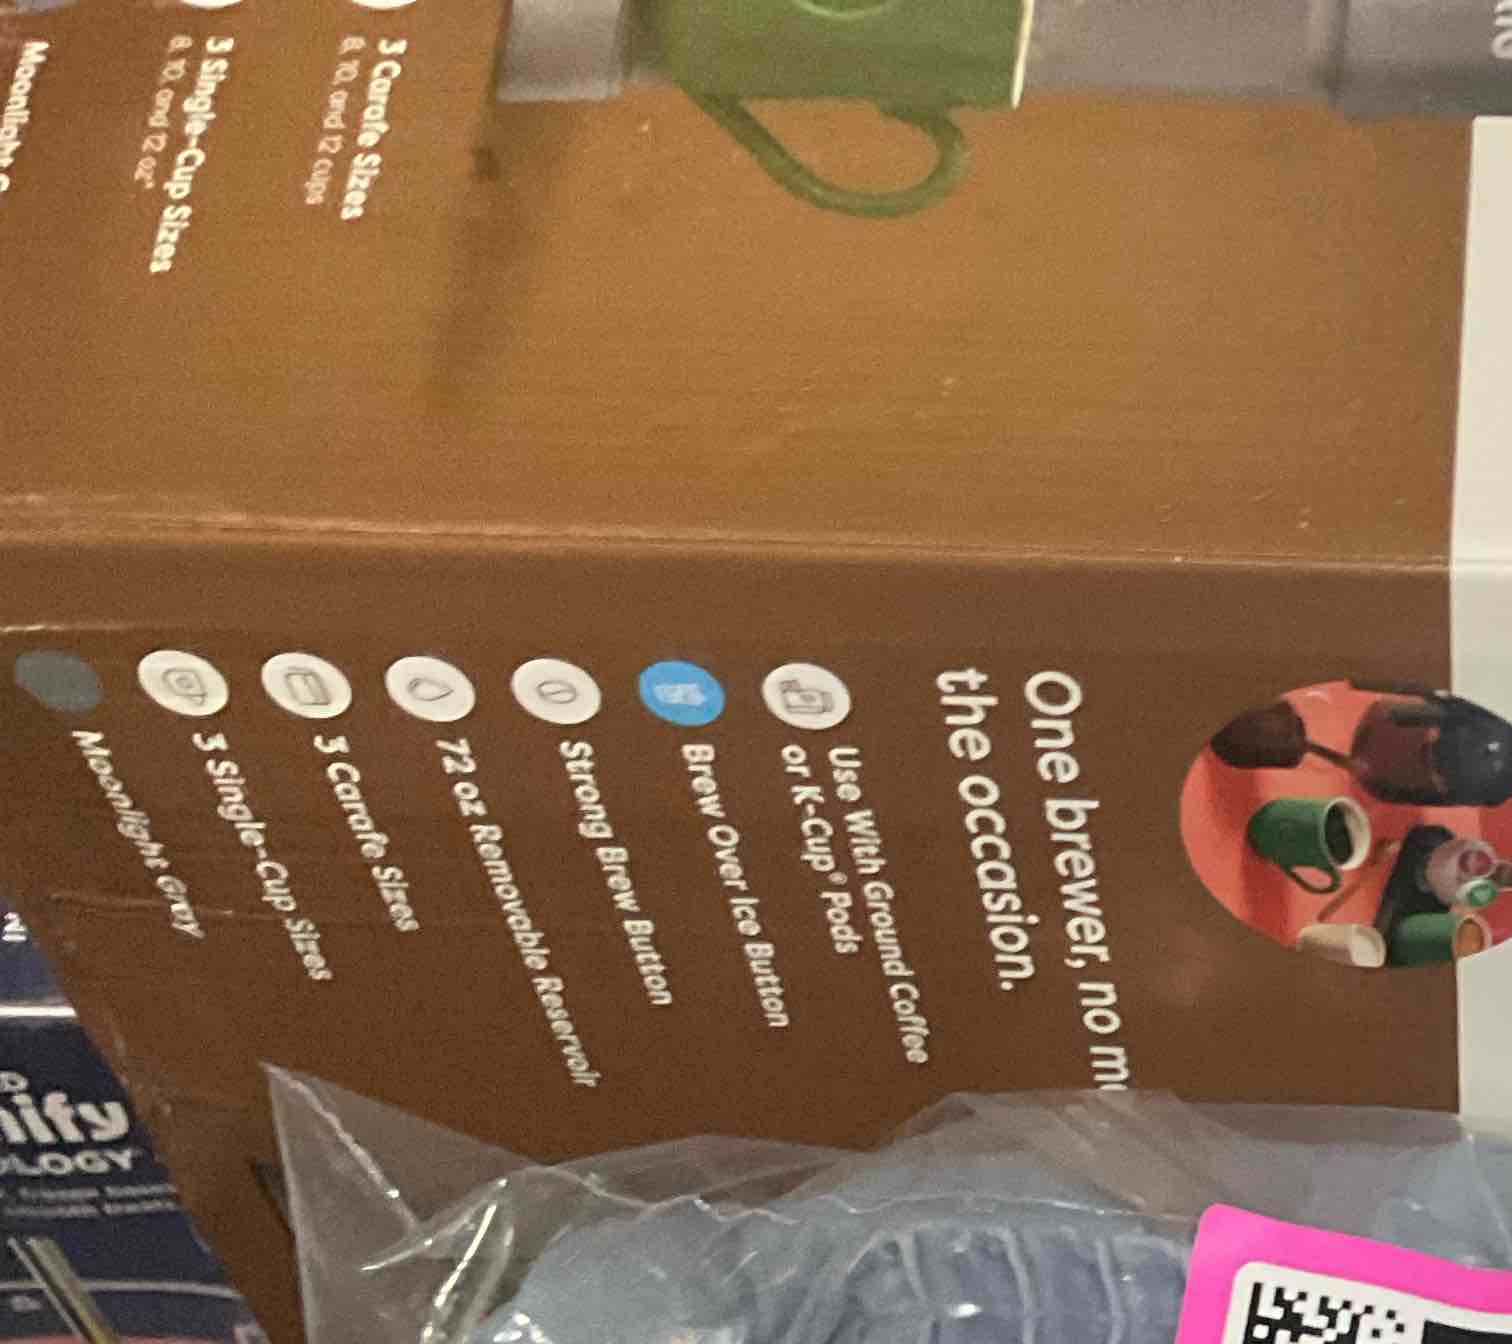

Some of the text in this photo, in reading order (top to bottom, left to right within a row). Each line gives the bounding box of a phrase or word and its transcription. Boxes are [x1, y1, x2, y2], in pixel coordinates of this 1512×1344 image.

[149, 37, 234, 274] 3 Single-Cup Sizes
[340, 37, 408, 220] 3 Carafe Sizes
[71, 730, 170, 870] Moonlight
[313, 734, 420, 933] 3 Carafe Sizes
[935, 667, 1041, 991] the occasion.
[1024, 670, 1083, 784] One
[192, 731, 335, 982] 3 Single-Cup Sizes
[435, 737, 601, 1088] 72 oz Removable Reservoir
[559, 740, 673, 1006] Strong Brew Button
[681, 743, 790, 1029] Brew Over Ice Button
[780, 743, 812, 778] or
[820, 890, 865, 955] Pods
[828, 745, 931, 1065] Use With Ground Coffee
[1044, 798, 1111, 969] brewer,
[1077, 981, 1122, 1034] no
